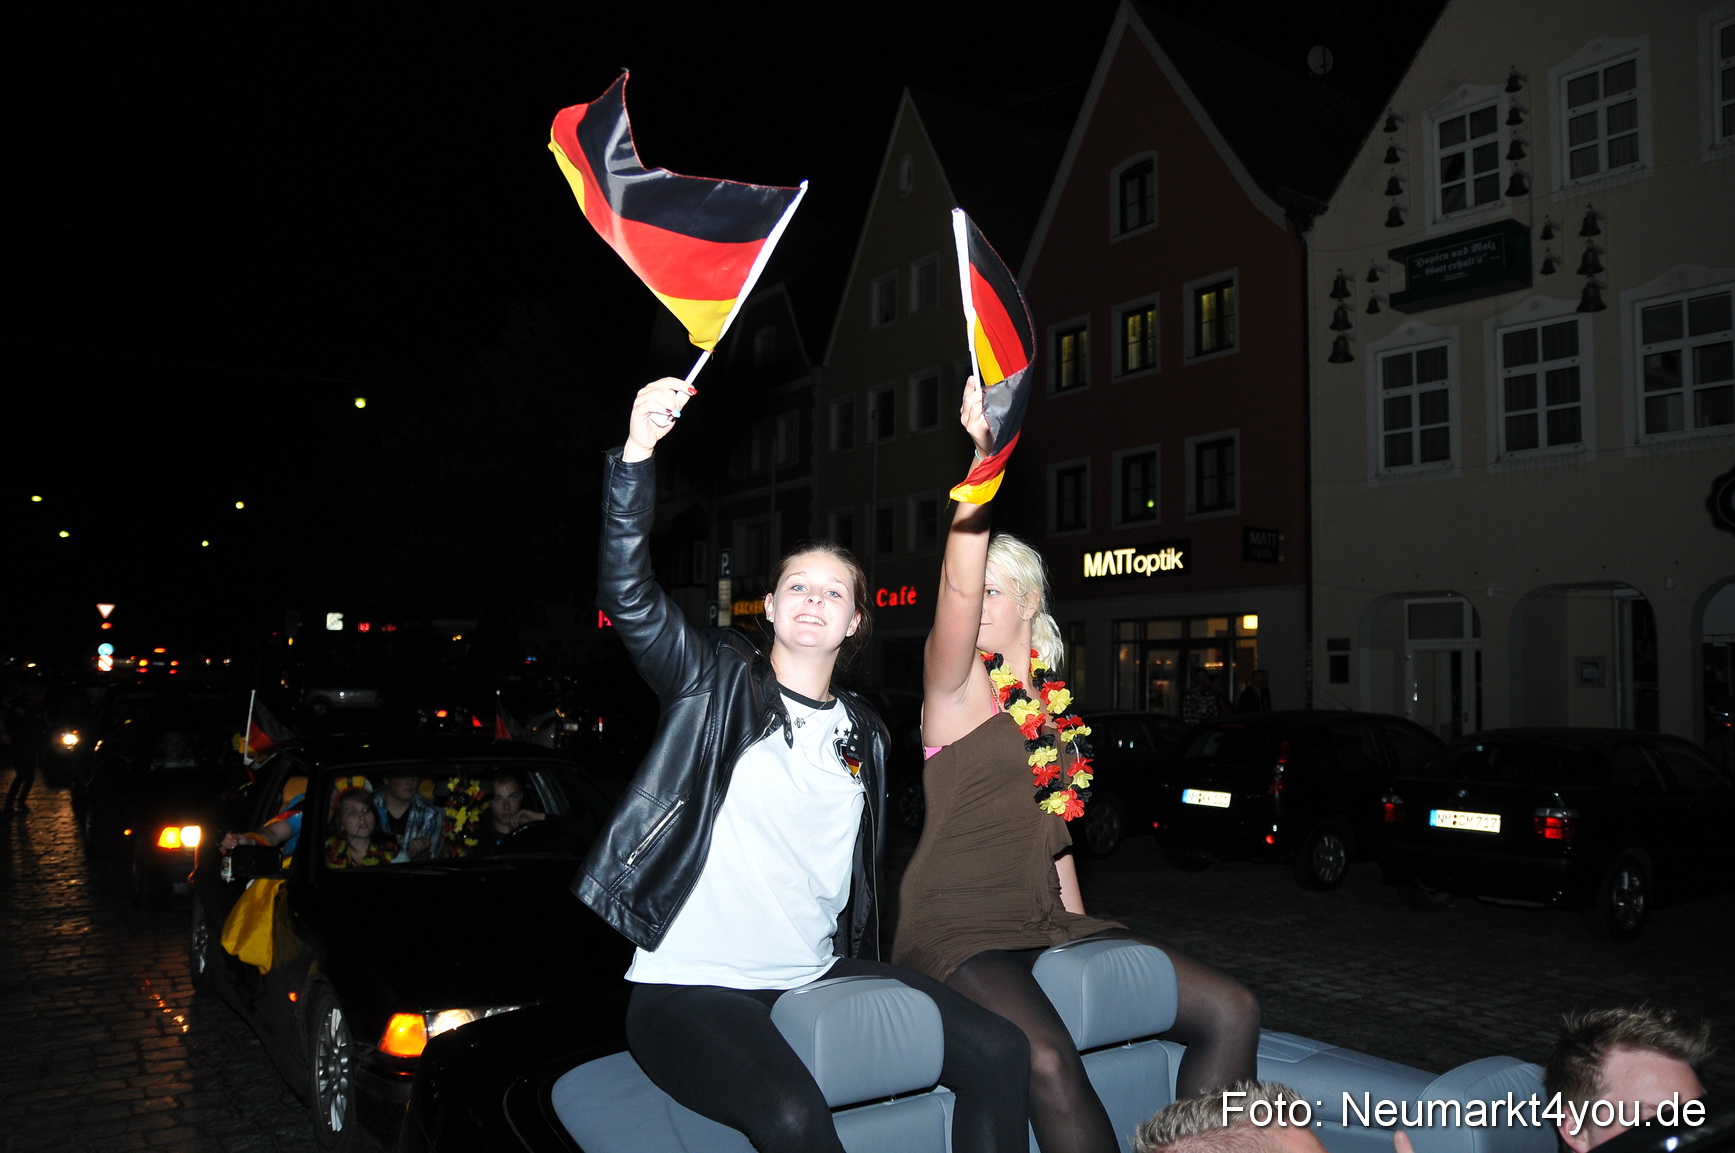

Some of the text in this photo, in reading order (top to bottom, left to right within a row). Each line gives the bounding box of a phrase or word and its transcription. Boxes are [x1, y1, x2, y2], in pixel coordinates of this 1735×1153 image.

[1451, 246, 1468, 258] und
[1470, 240, 1496, 253] Malz
[1424, 264, 1446, 276] Gott
[1250, 531, 1277, 547] MATT
[876, 585, 917, 607] Café
